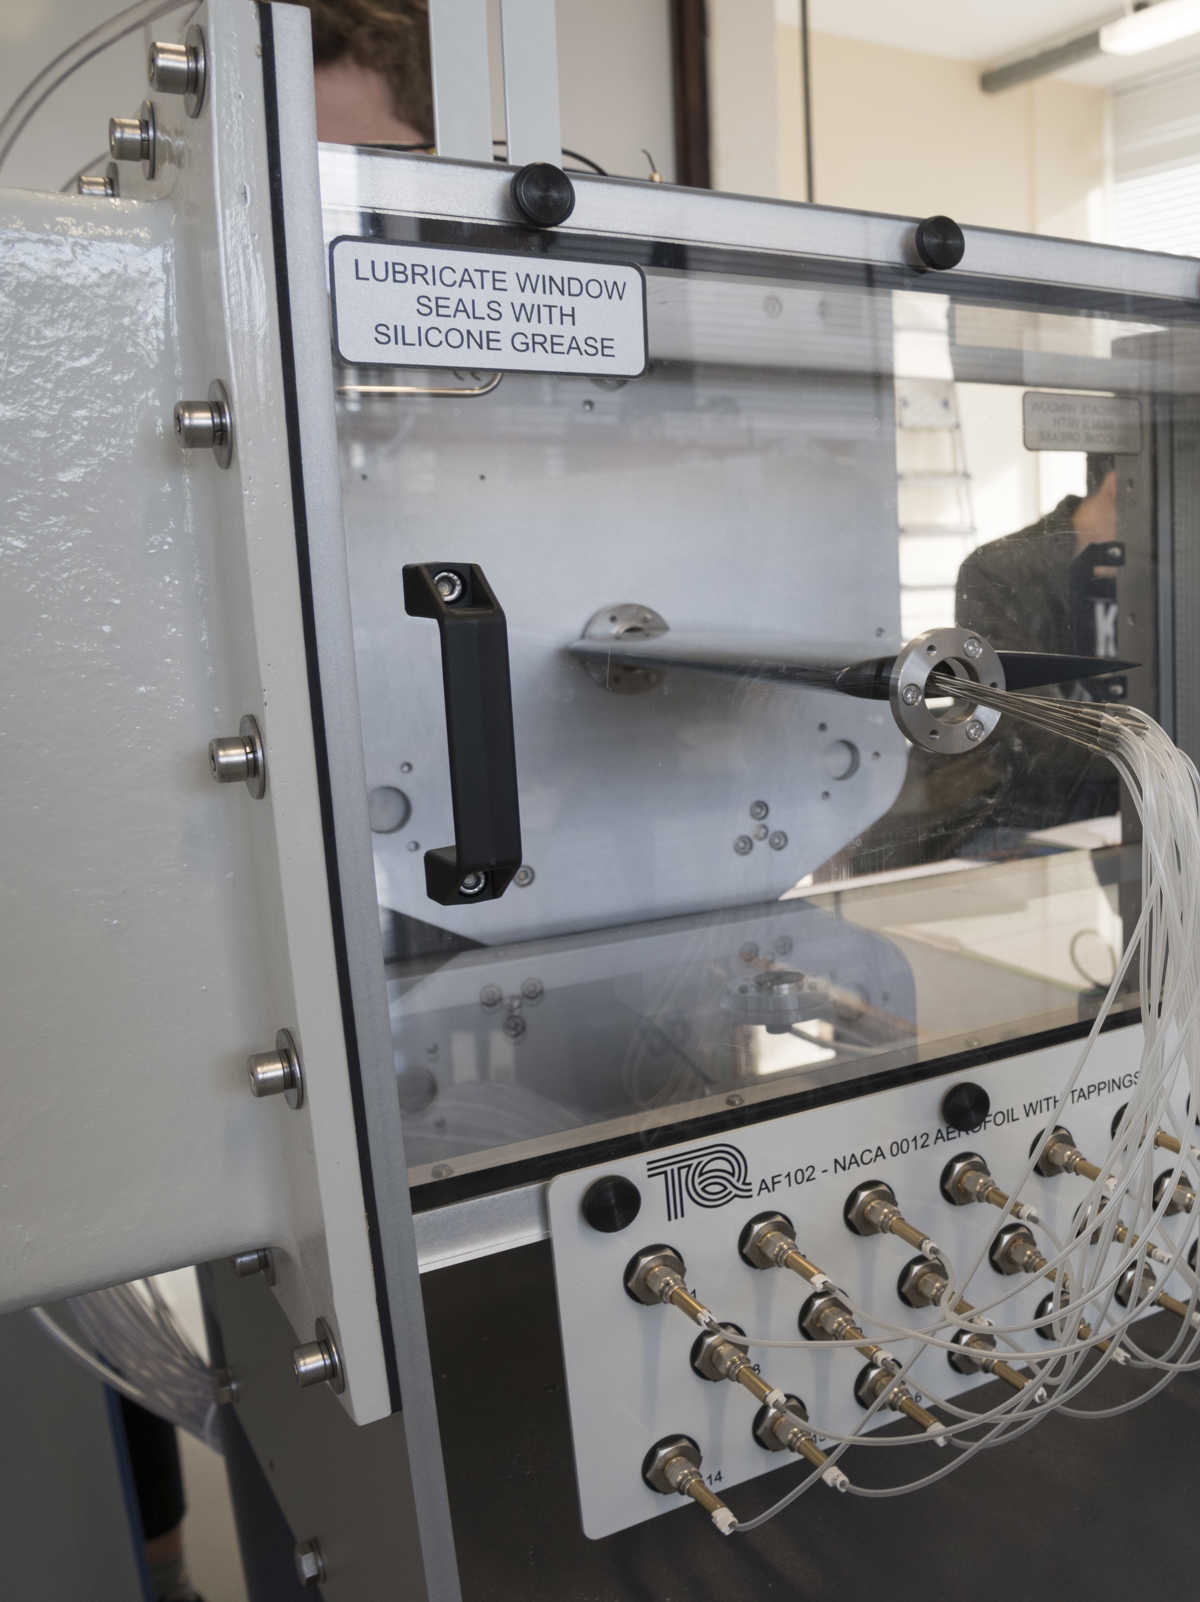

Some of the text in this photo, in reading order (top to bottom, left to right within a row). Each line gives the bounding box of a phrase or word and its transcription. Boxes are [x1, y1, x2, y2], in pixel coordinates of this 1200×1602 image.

[354, 258, 627, 301] LUBRICATE WINDOW
[416, 294, 577, 326] SEALS WITH
[373, 323, 616, 358] SILICONE GREASE
[757, 1164, 816, 1197] AF102
[832, 1145, 887, 1175] NACA
[889, 1132, 931, 1157] 0012
[706, 1470, 723, 1486] 14
